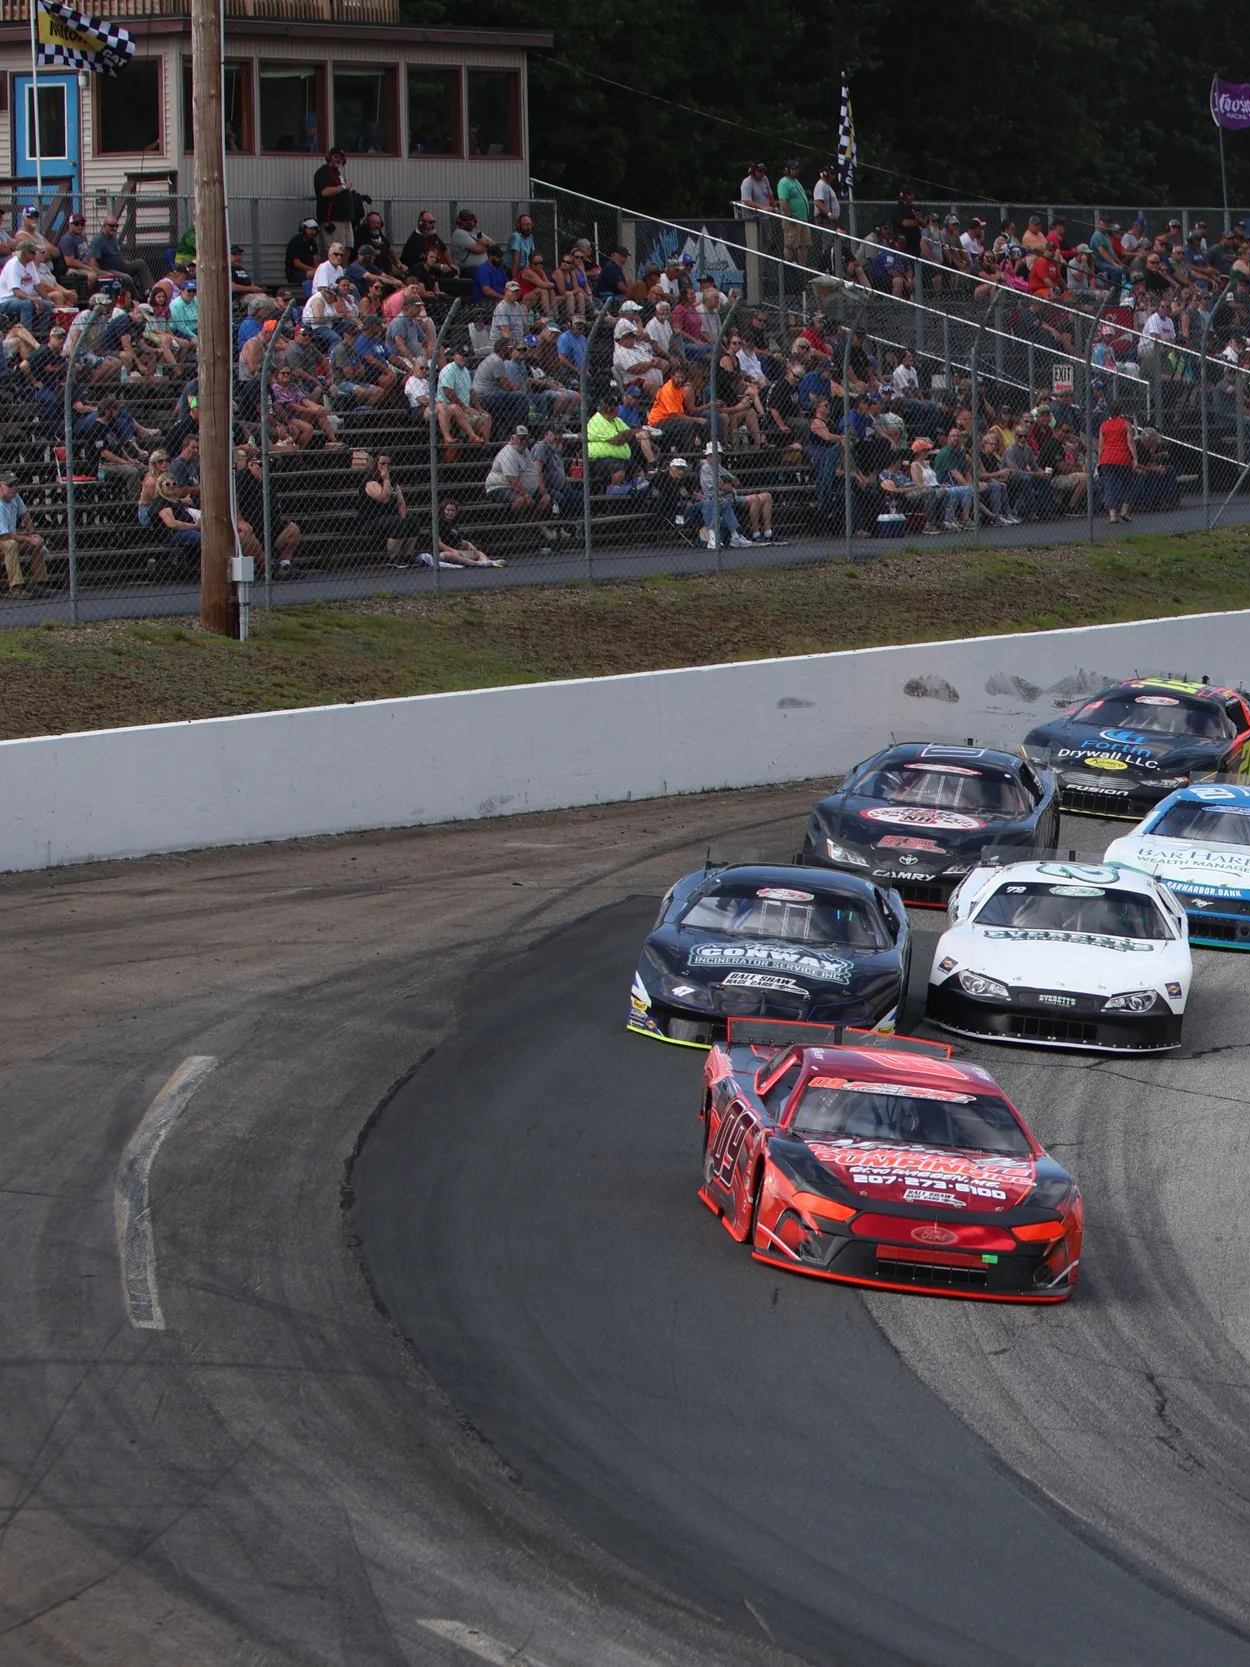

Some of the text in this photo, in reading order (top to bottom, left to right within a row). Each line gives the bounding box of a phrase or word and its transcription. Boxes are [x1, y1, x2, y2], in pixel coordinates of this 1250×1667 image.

[1054, 367, 1072, 381] EXIT
[1080, 740, 1154, 758] Fortin
[1058, 748, 1161, 771] Drywall LLC.
[1066, 784, 1129, 796] FUSION
[1138, 848, 1183, 860] BAR
[1136, 856, 1191, 866] WEALTH
[872, 869, 936, 881] CAMRY
[1006, 886, 1027, 894] 72
[695, 957, 772, 968] INCINERATOR
[772, 961, 817, 976] SERVICE
[700, 948, 844, 973] CONWAY
[729, 972, 793, 986] DALE SHAW
[749, 980, 775, 988] CARS
[808, 1076, 848, 1089] 09
[713, 1099, 757, 1188] 09
[927, 1191, 953, 1199] SHAW
[920, 1228, 949, 1243] Ford
